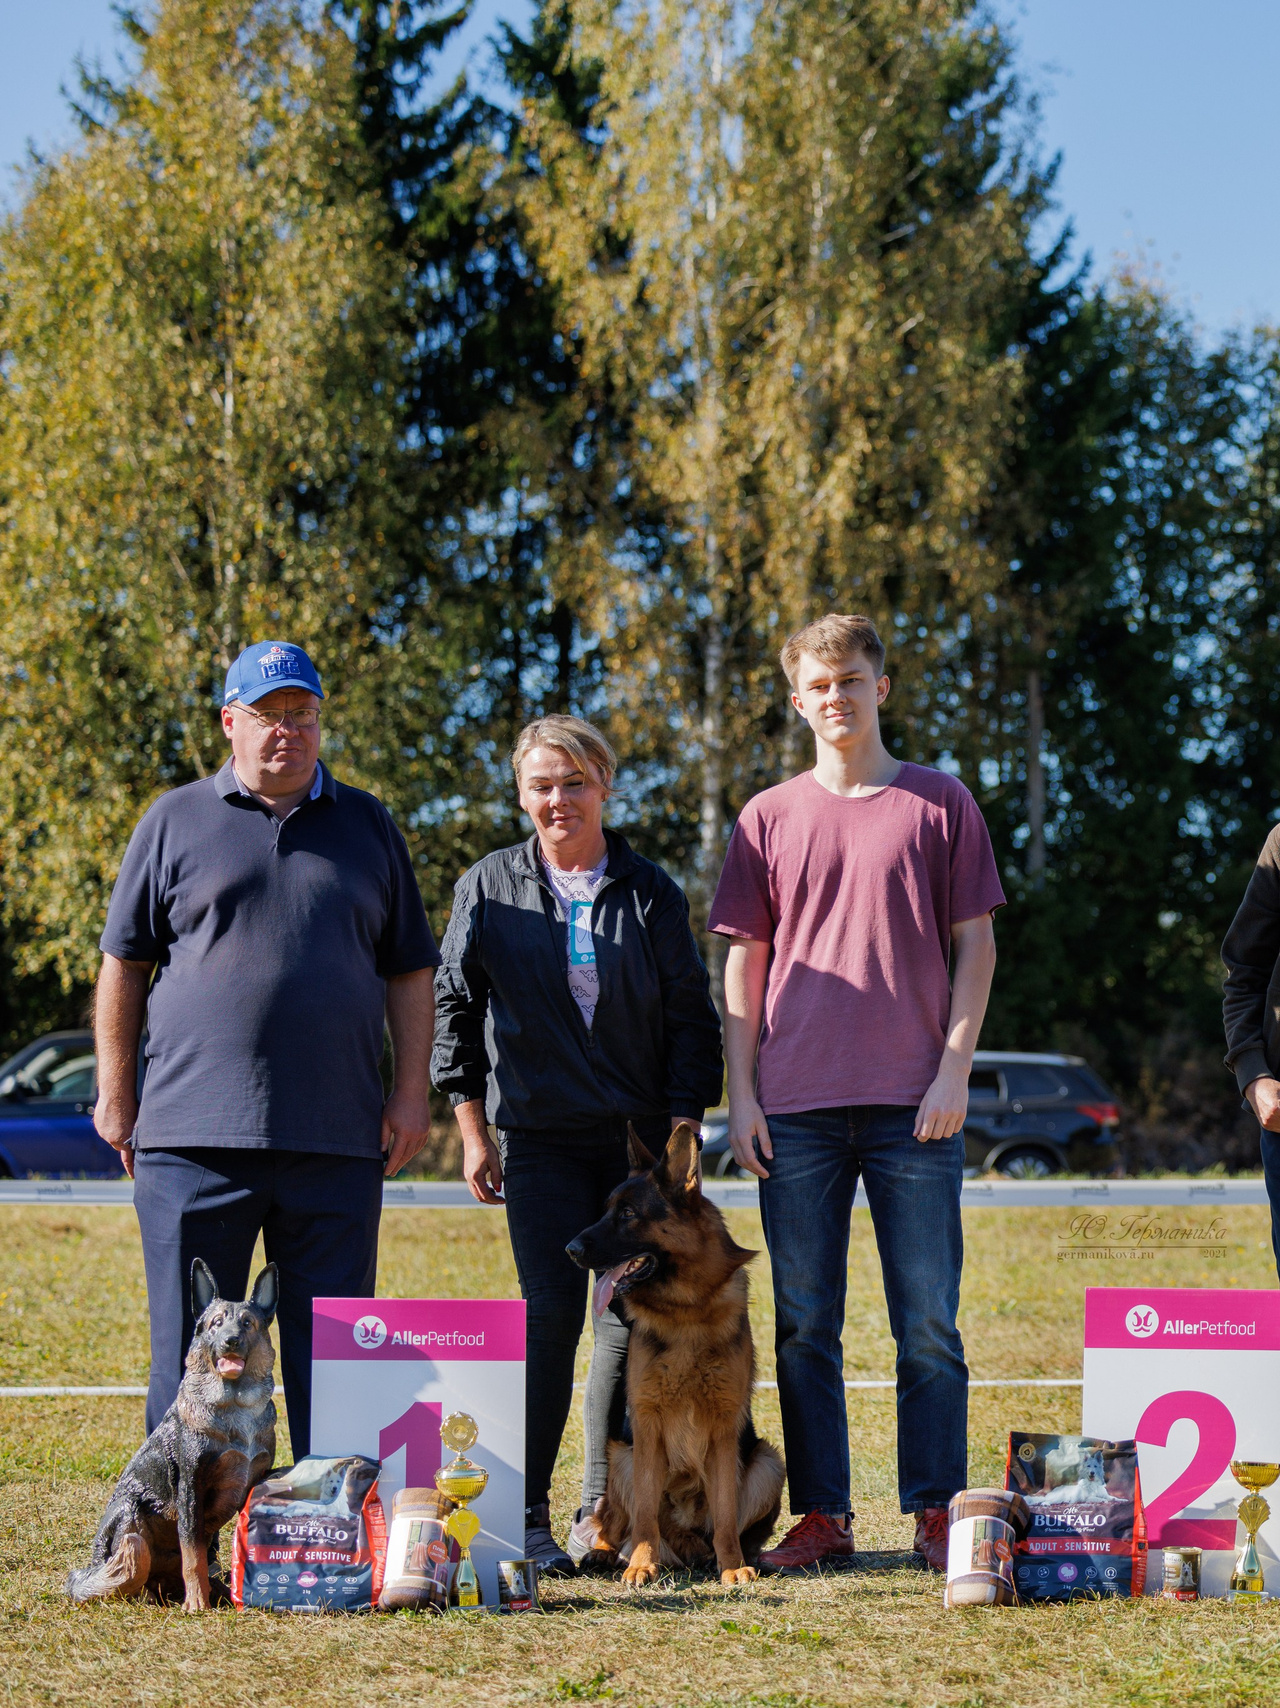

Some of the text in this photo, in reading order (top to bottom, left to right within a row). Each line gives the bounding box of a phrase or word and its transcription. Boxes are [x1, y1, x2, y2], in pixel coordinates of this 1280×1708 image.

[1163, 1320, 1256, 1335] AllerPetfood
[391, 1331, 485, 1346] AllerPetfood
[1136, 1390, 1236, 1549] 2
[379, 1402, 459, 1563] 1
[1034, 1514, 1107, 1527] BUFFALO
[275, 1524, 348, 1541] BUFFALO
[1029, 1542, 1111, 1552] ADULT SENSITIVE
[269, 1550, 351, 1562] ADULT SENSITIVE
